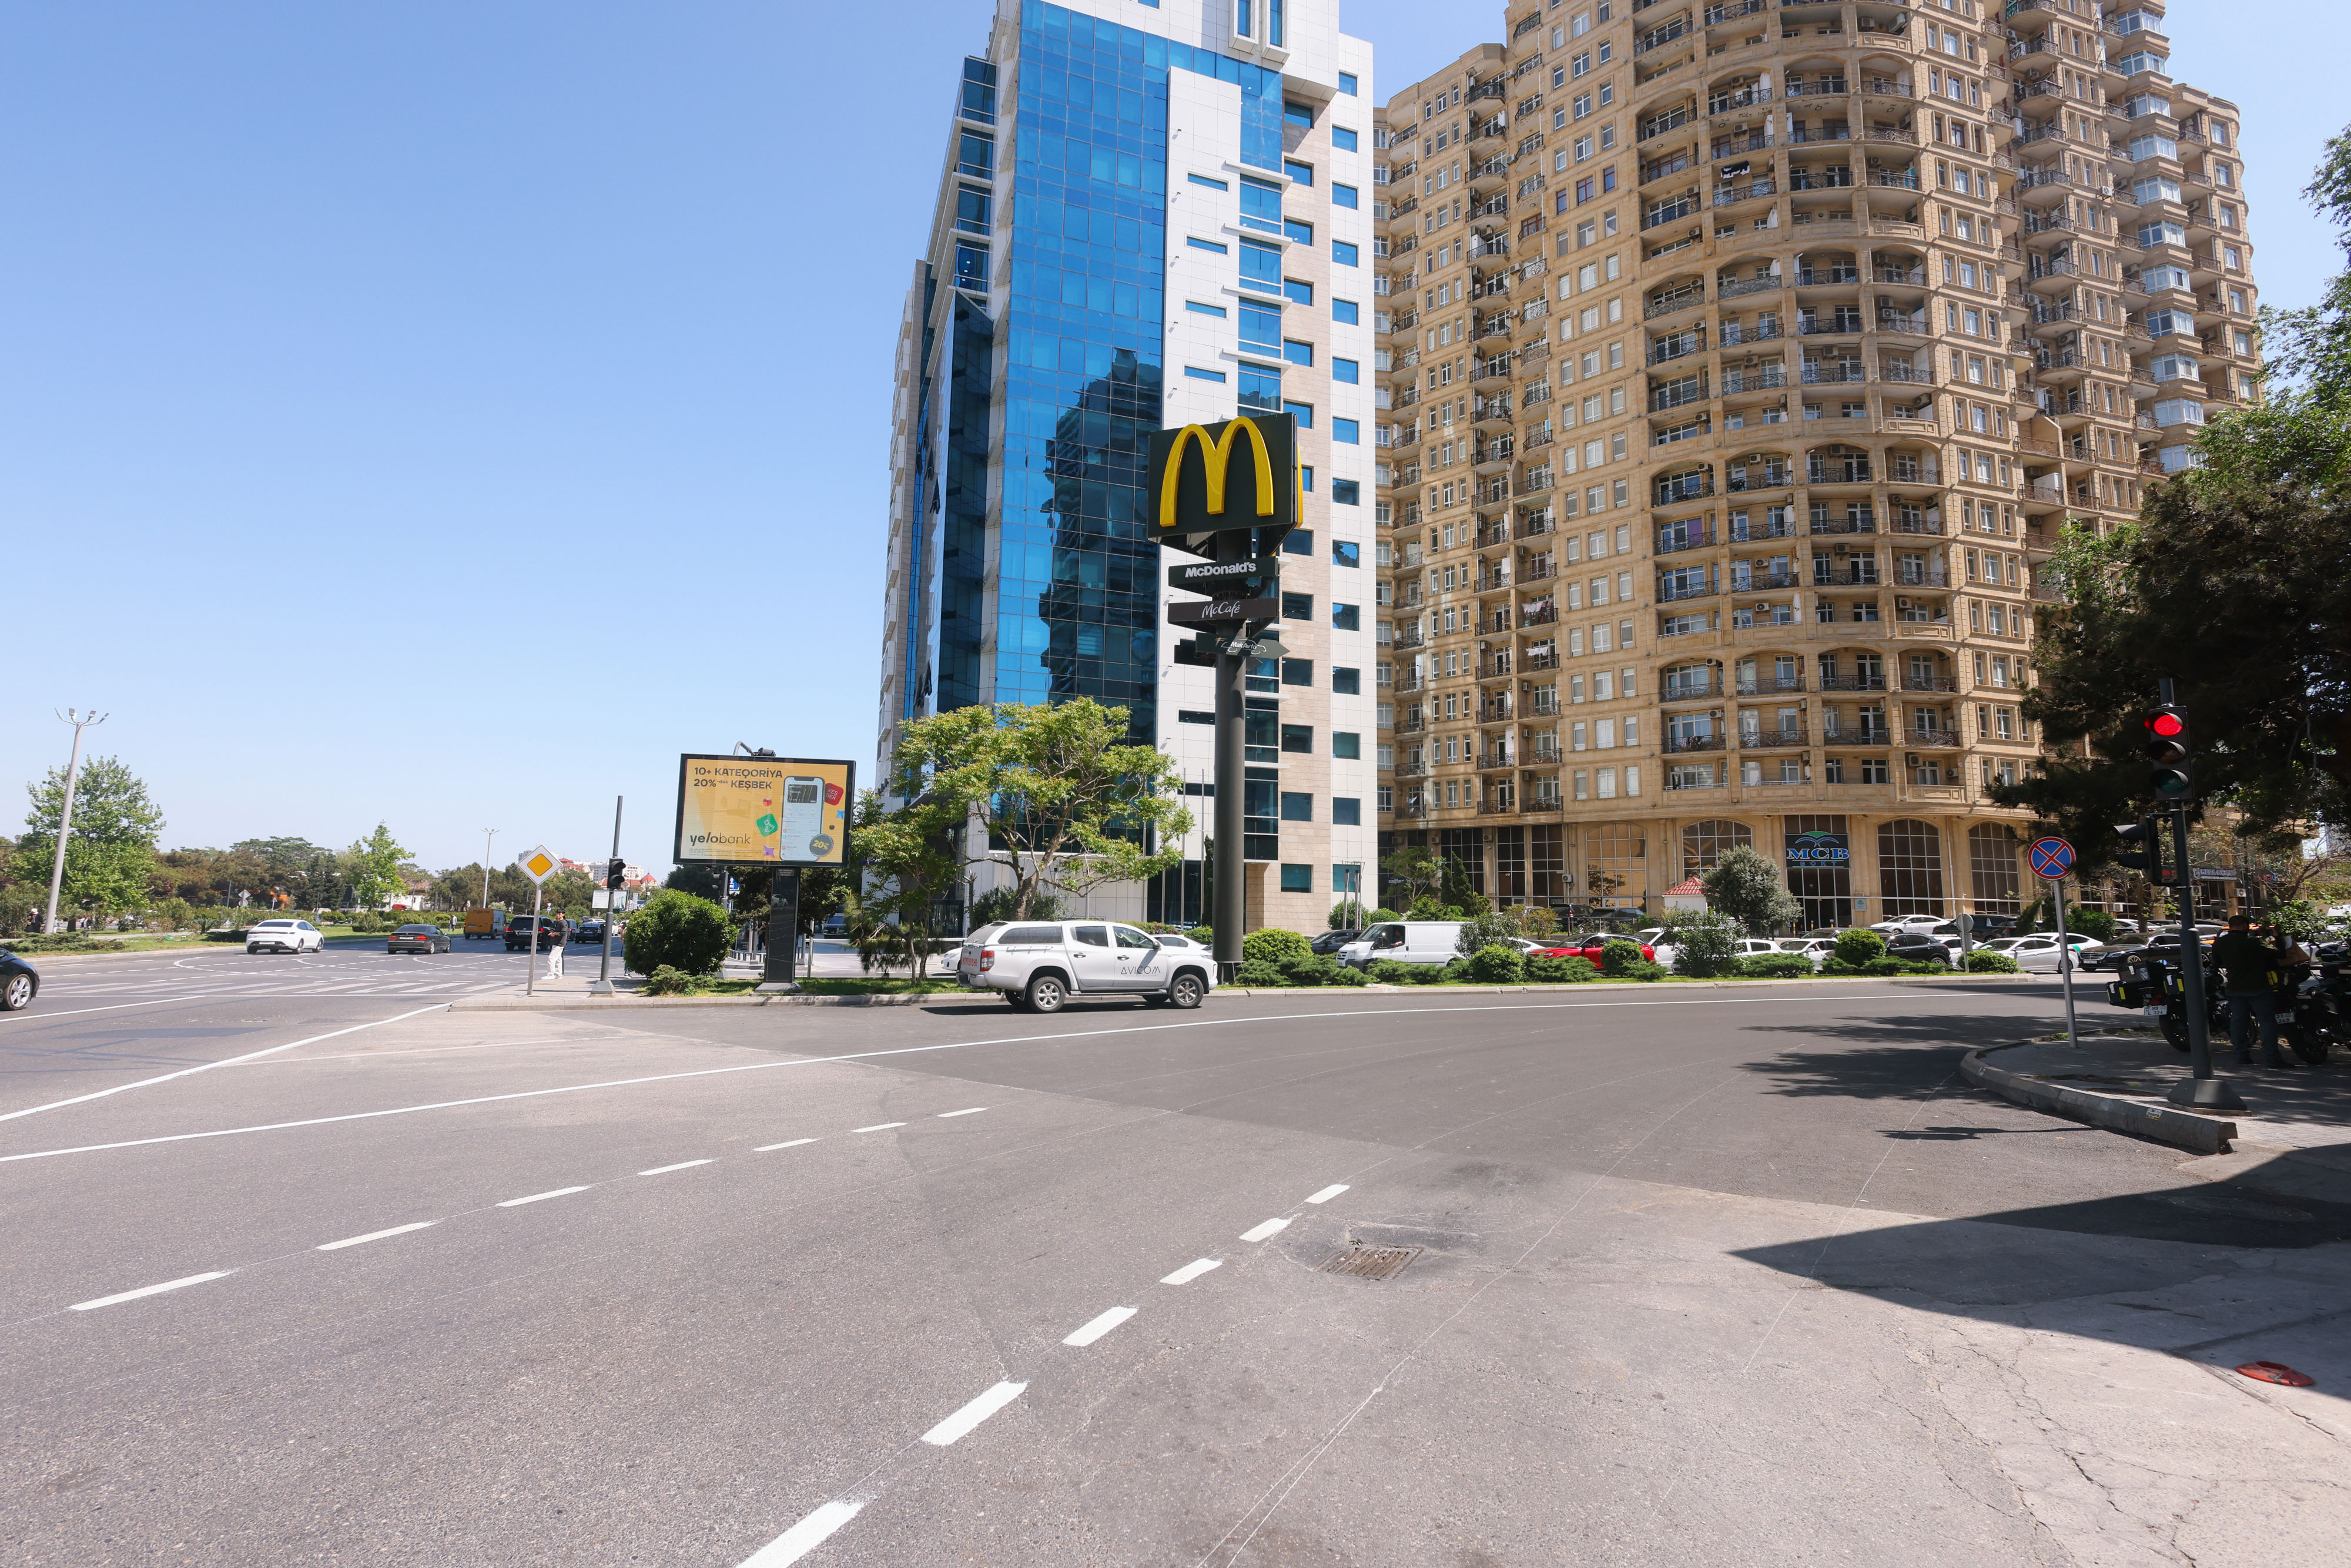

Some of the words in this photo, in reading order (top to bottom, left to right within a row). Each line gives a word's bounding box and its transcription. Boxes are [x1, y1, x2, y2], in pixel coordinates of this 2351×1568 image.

[1185, 562, 1257, 578] McDonald's
[1201, 601, 1241, 619] McCafé
[1230, 641, 1257, 649] MakAvto
[695, 767, 712, 775] 10+
[715, 768, 783, 779] KATEQORİYA
[731, 780, 773, 790] KEŞBEK
[690, 832, 751, 846] yelobank
[1786, 848, 1850, 859] MCB
[1120, 966, 1161, 974] AVICOM
